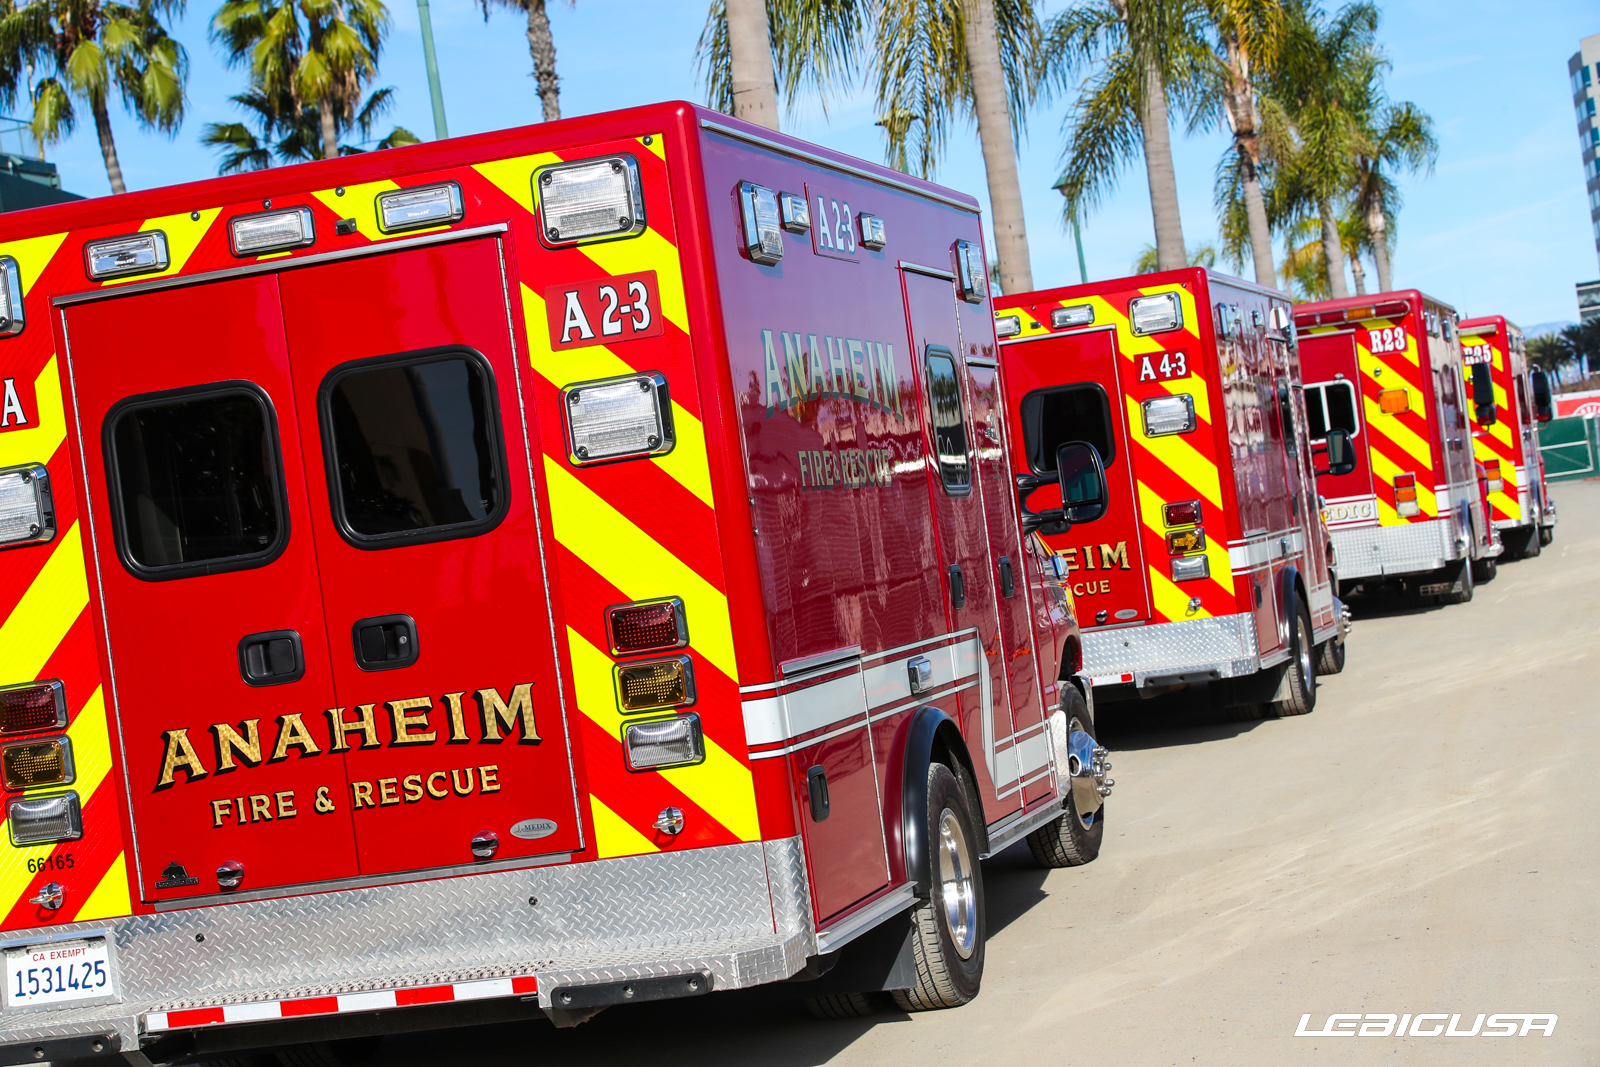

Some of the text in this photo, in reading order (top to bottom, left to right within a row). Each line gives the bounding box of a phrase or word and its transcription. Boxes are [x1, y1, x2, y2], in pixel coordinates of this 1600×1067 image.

[560, 280, 651, 343] A 2-3
[1369, 326, 1405, 353] R23
[760, 328, 904, 423] ANAHEIM
[1139, 351, 1187, 382] A 4-3
[0, 377, 28, 427] A
[797, 450, 834, 492] FIRE
[839, 448, 893, 490] RESCUE
[1073, 580, 1111, 597] CUE
[151, 682, 542, 794] ANAHEIM
[211, 764, 501, 828] FIRE & RESCUE
[27, 853, 75, 874] 66165
[32, 947, 86, 962] CA EXEMPT
[15, 959, 106, 997] 1531425
